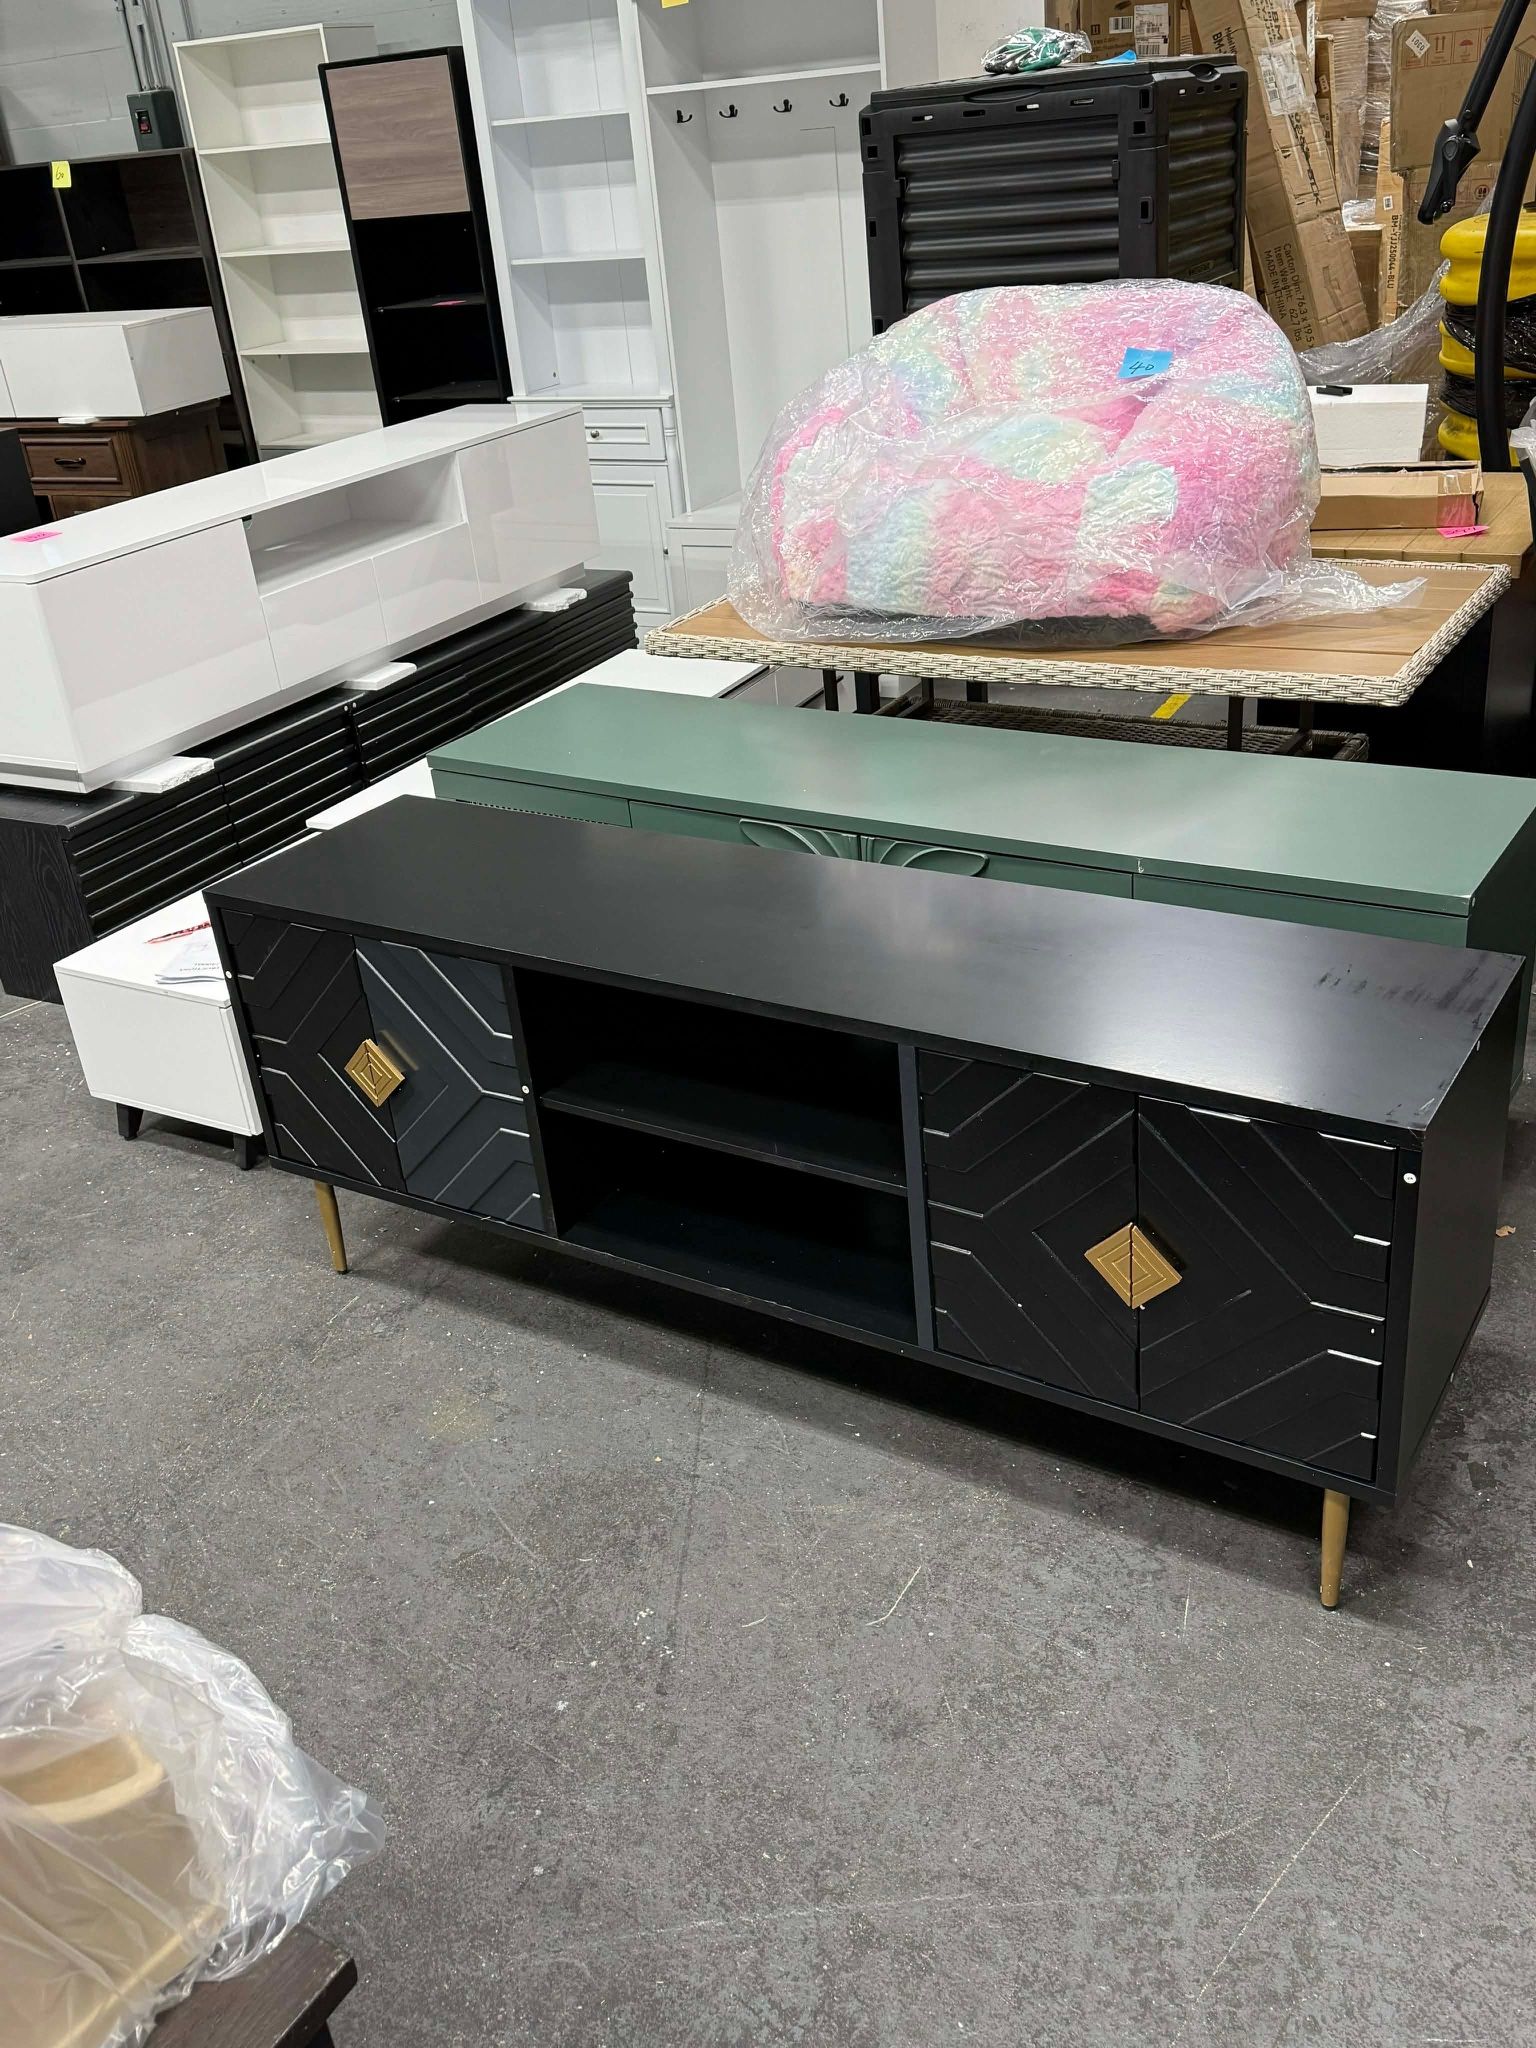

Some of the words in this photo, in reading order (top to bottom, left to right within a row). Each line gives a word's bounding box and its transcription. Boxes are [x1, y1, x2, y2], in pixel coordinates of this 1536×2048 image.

[1264, 250, 1278, 277] MADE
[1271, 279, 1279, 289] IN
[1273, 246, 1284, 266] Item
[1294, 328, 1302, 342] lbs
[1283, 243, 1296, 274] Carton
[1303, 323, 1315, 343] 19.5
[1273, 289, 1288, 320] CHINA
